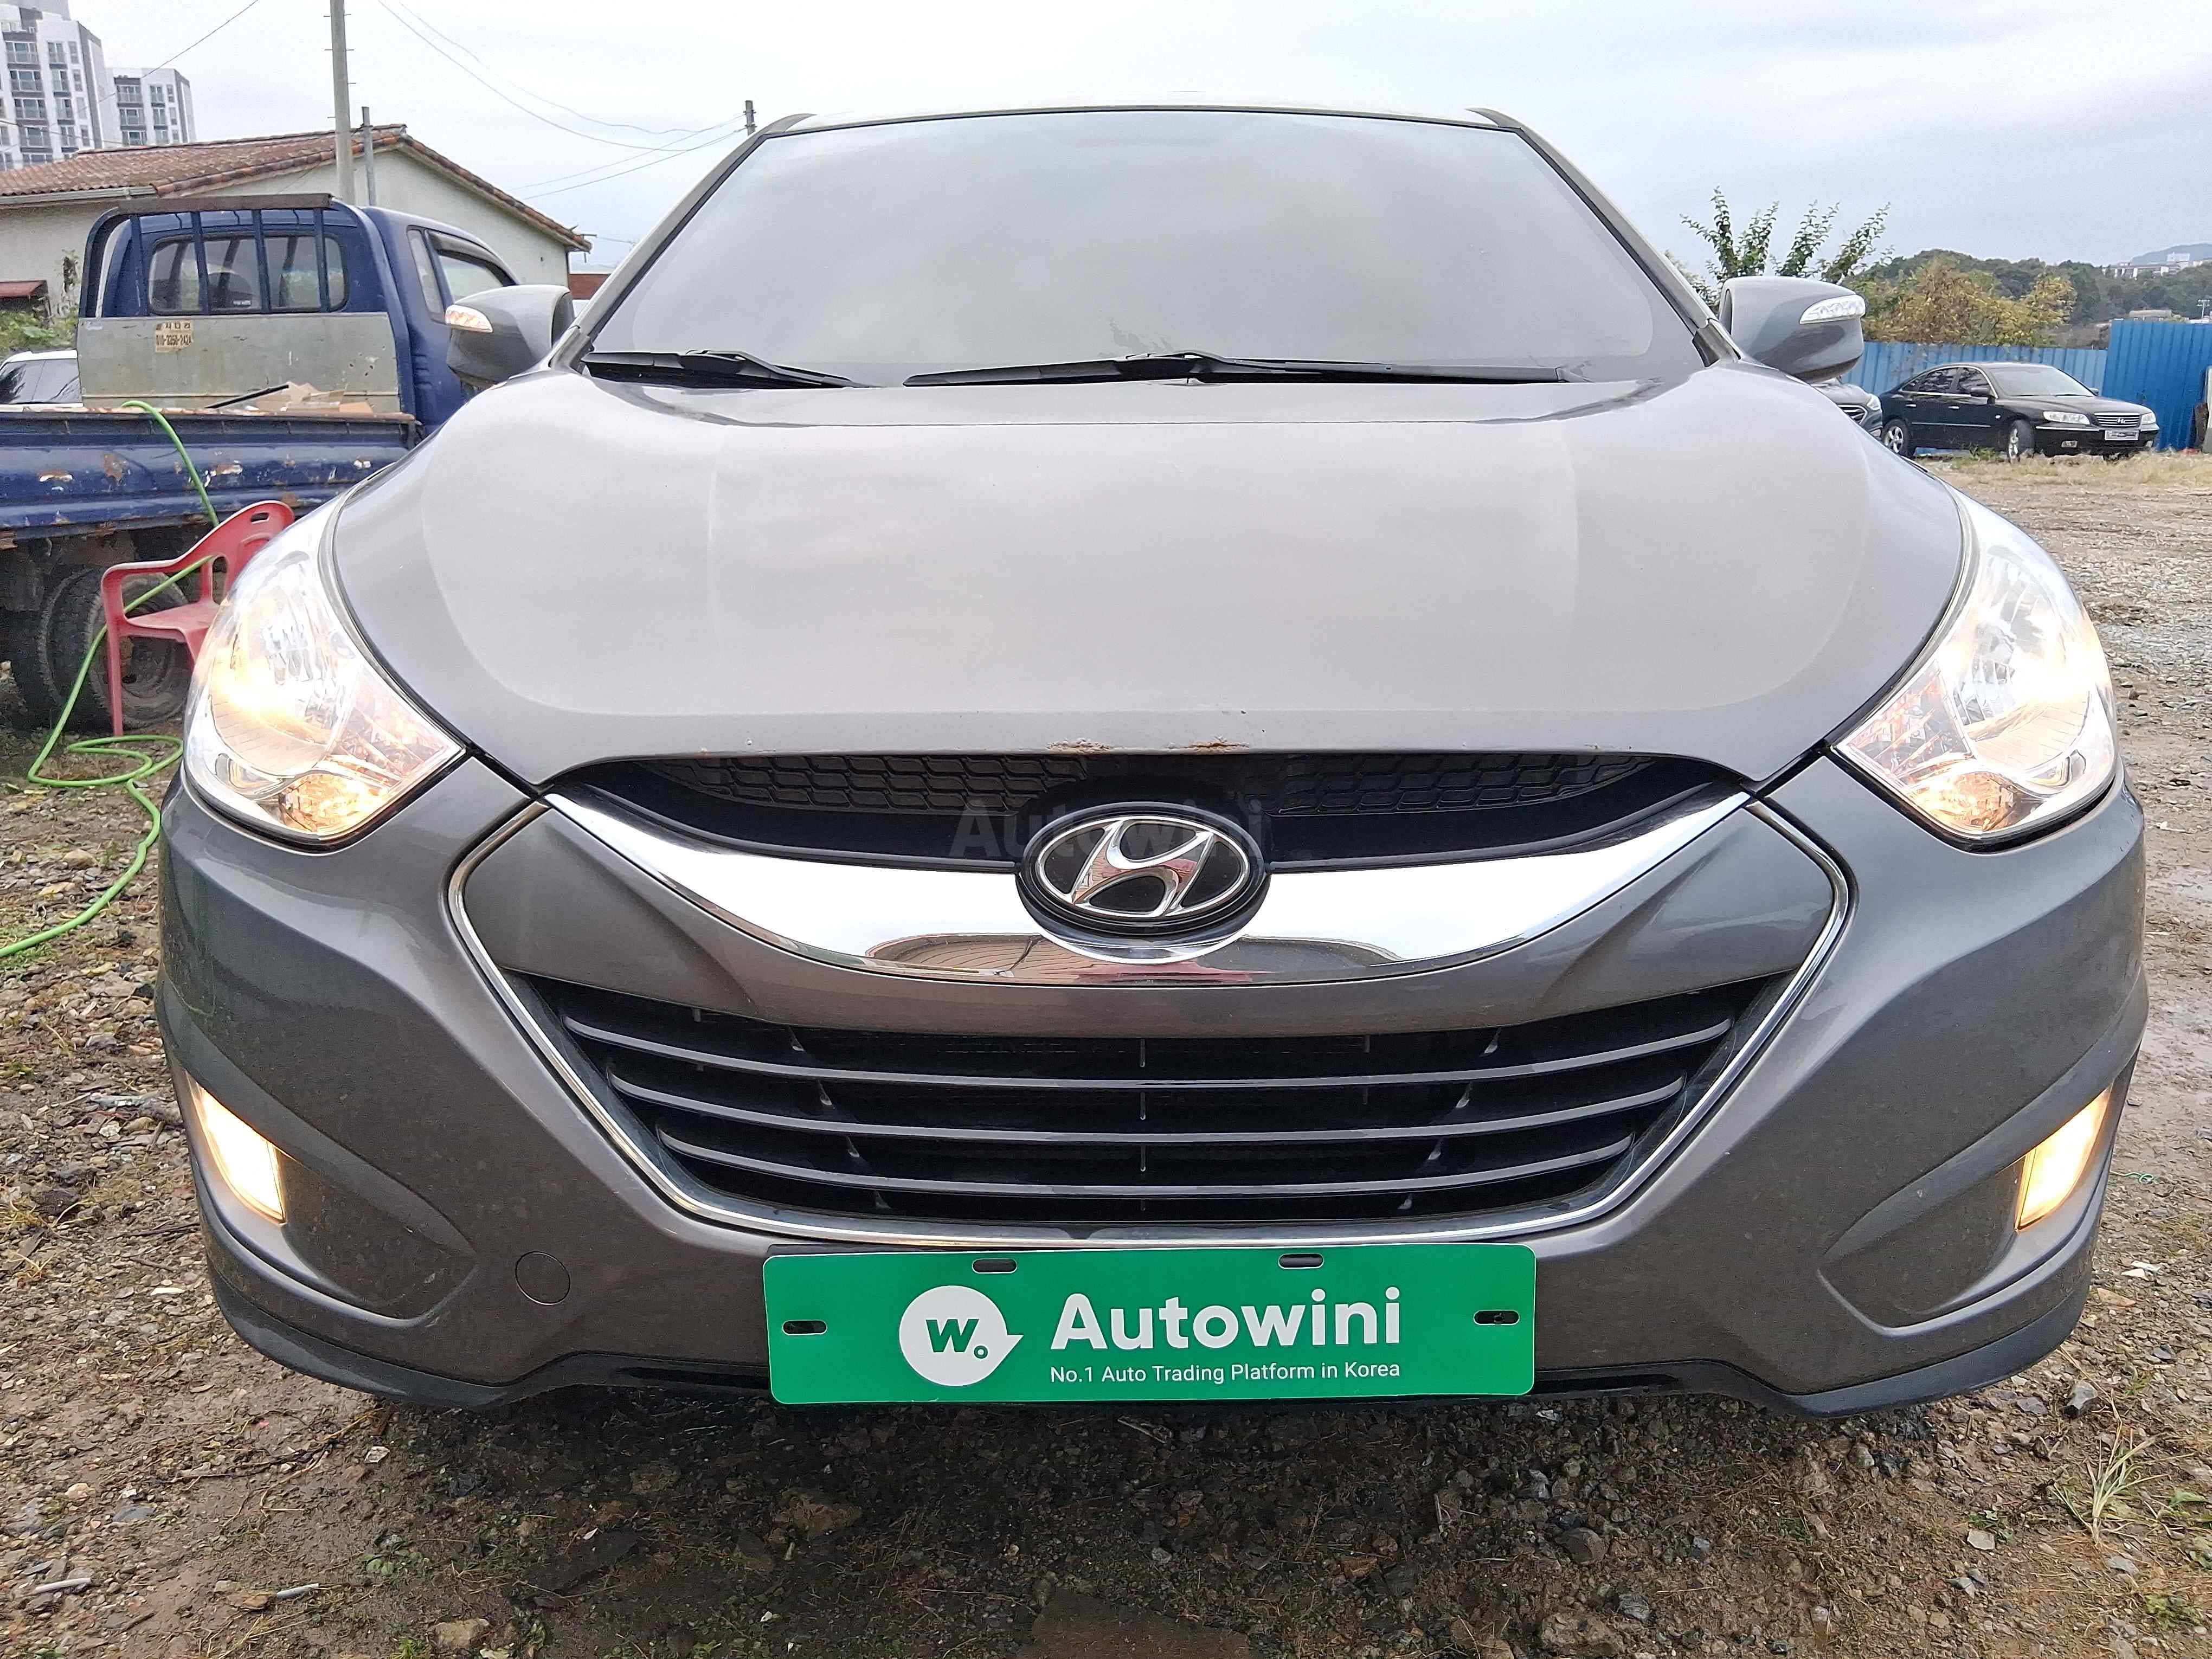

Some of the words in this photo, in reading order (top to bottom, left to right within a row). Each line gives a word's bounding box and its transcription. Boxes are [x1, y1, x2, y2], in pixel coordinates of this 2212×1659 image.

[1051, 1287, 1400, 1350] Autowini
[1051, 1366, 1092, 1382] No.1
[1101, 1366, 1146, 1382] Auto
[1152, 1365, 1224, 1385] Trading
[1231, 1362, 1315, 1380] Platform
[1322, 1362, 1338, 1378] in
[1345, 1361, 1400, 1378] Korea
